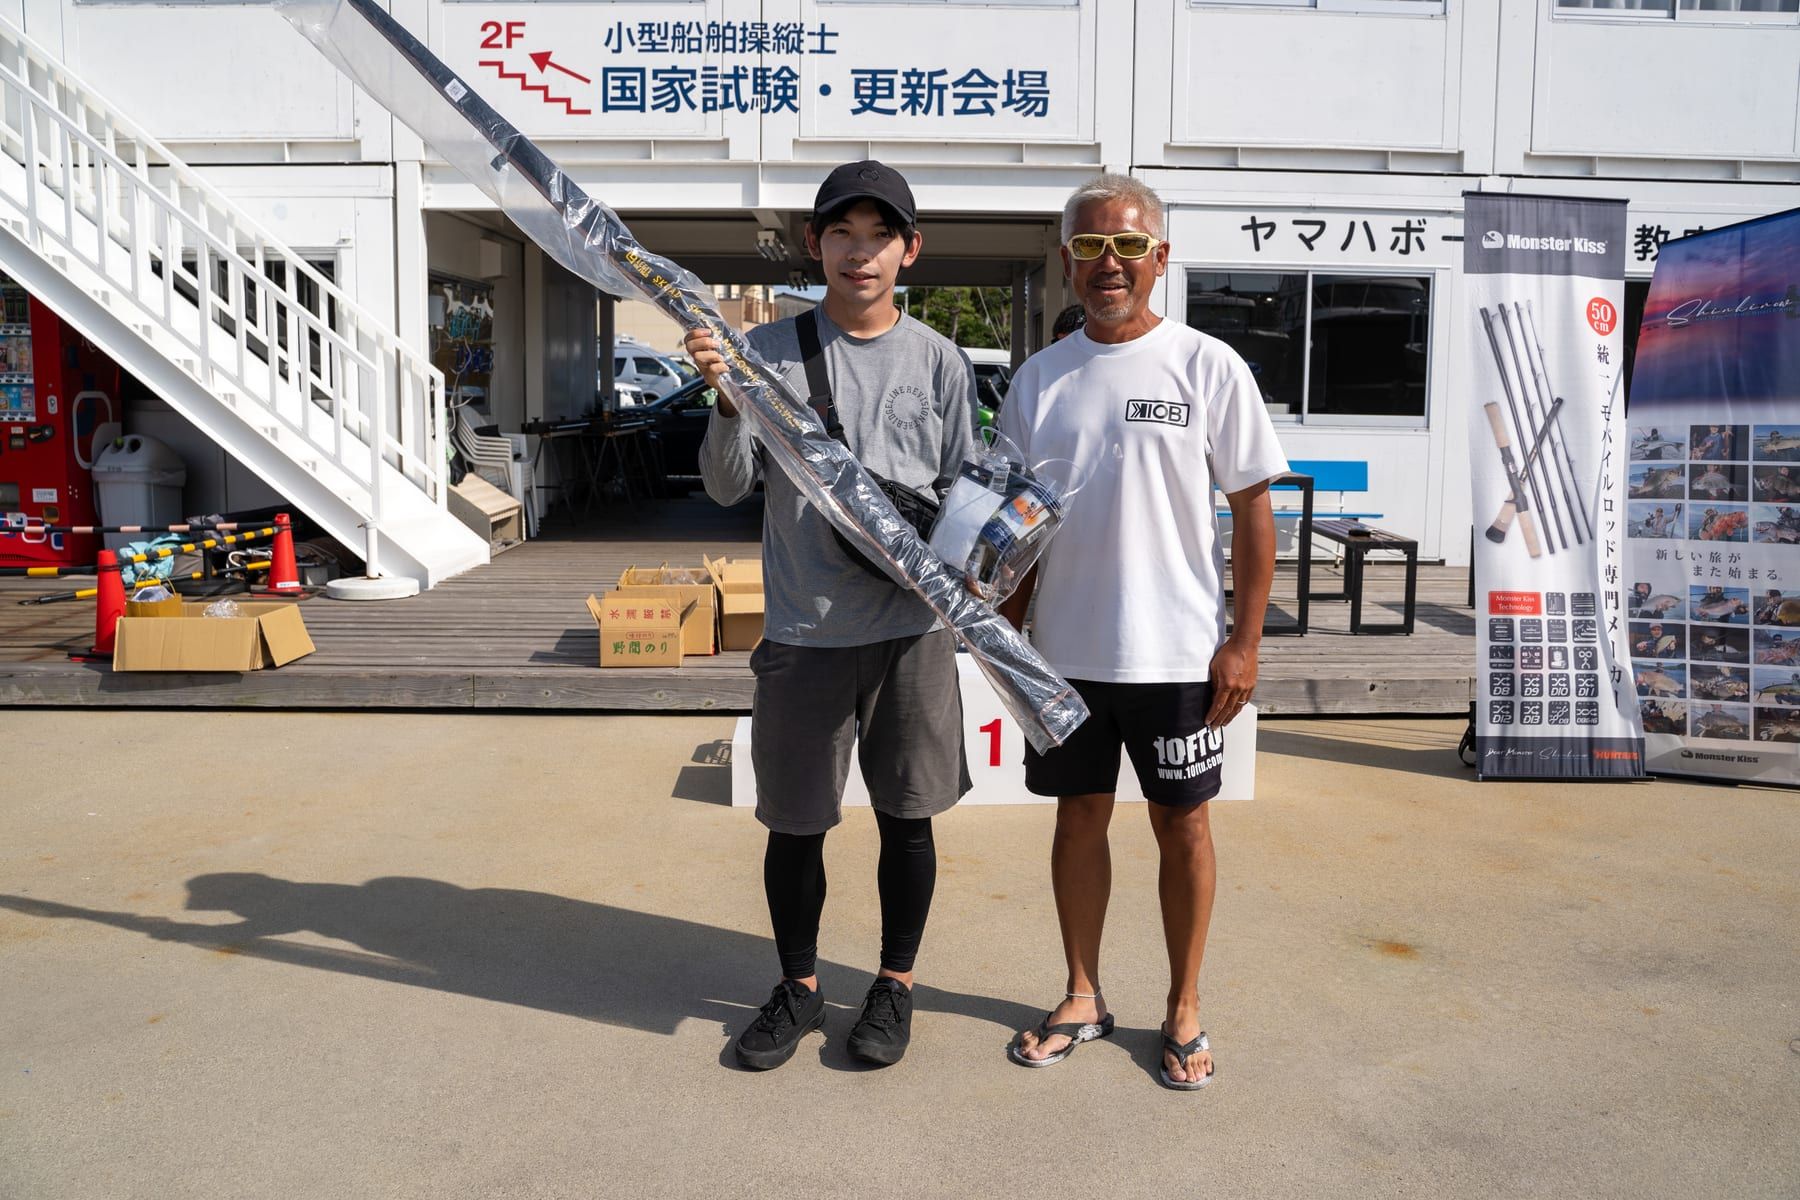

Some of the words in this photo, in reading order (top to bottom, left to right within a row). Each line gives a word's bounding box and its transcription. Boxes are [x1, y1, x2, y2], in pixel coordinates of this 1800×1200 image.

[481, 21, 525, 48] 2F
[604, 22, 838, 55] 小型船舶操縦士
[602, 65, 1050, 117] 国家試験・更新会場
[1507, 234, 1572, 251] Monster
[1574, 237, 1606, 254] Kiss
[1591, 302, 1612, 322] 50
[1594, 321, 1610, 333] cm
[1656, 548, 1741, 564] 新しい旅が
[1497, 603, 1534, 612] Technology
[1493, 687, 1510, 695] D8
[1524, 688, 1540, 696] D9
[1551, 688, 1568, 696] D10
[1493, 715, 1512, 723] D12
[1523, 715, 1541, 724] D13
[979, 718, 1002, 767] 1
[1695, 752, 1736, 762] Monster
[1737, 755, 1759, 763] Kiss
